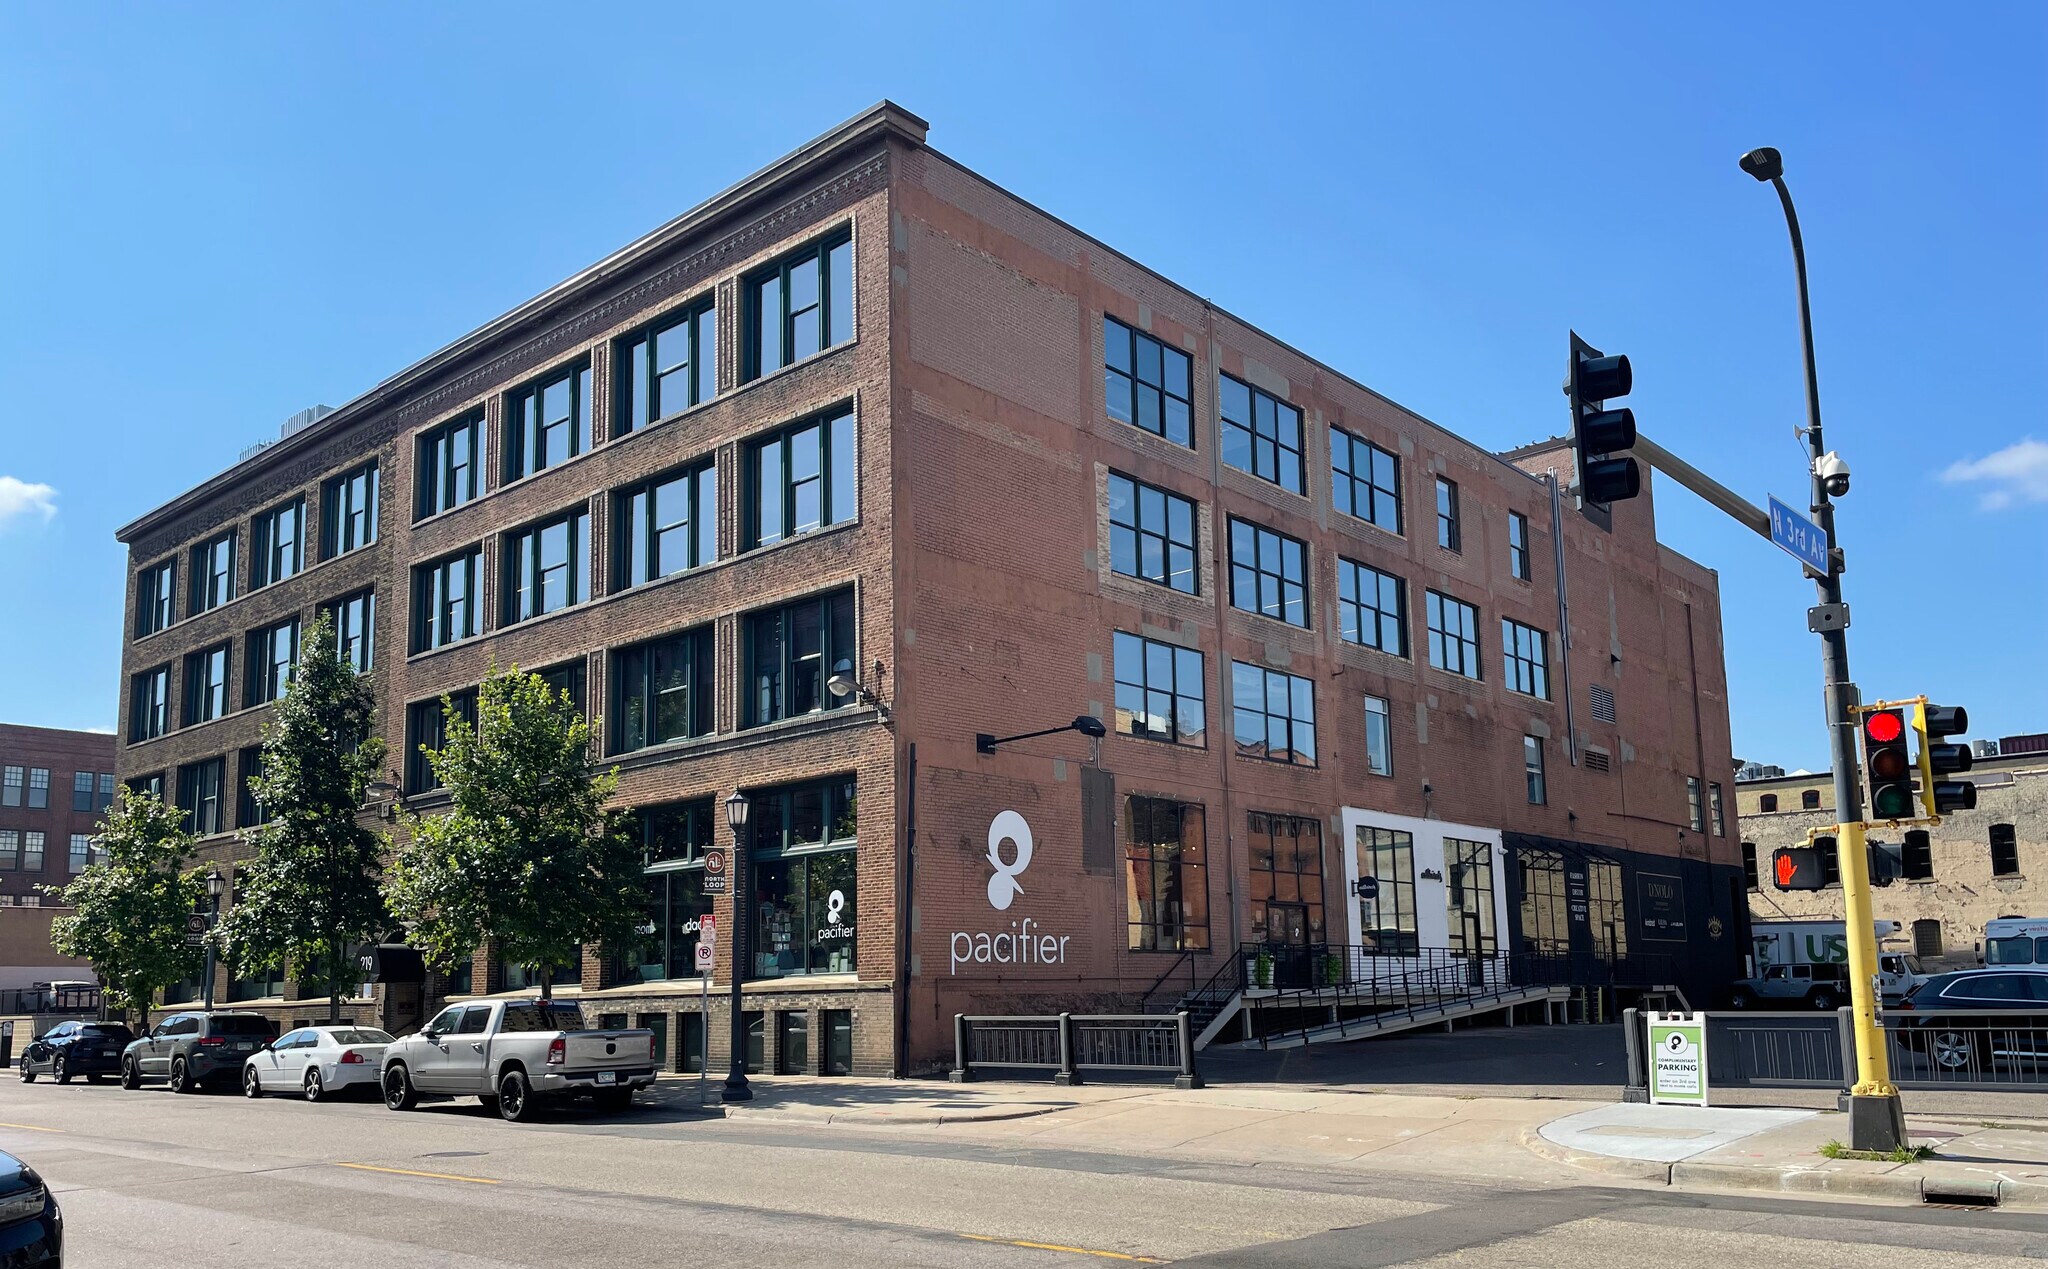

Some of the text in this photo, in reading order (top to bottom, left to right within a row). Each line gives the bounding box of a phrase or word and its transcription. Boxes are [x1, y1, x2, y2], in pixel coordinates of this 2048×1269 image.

[1773, 507, 1824, 563] N 3rd Av
[818, 923, 855, 943] pacifier
[950, 917, 1070, 976] pacifier
